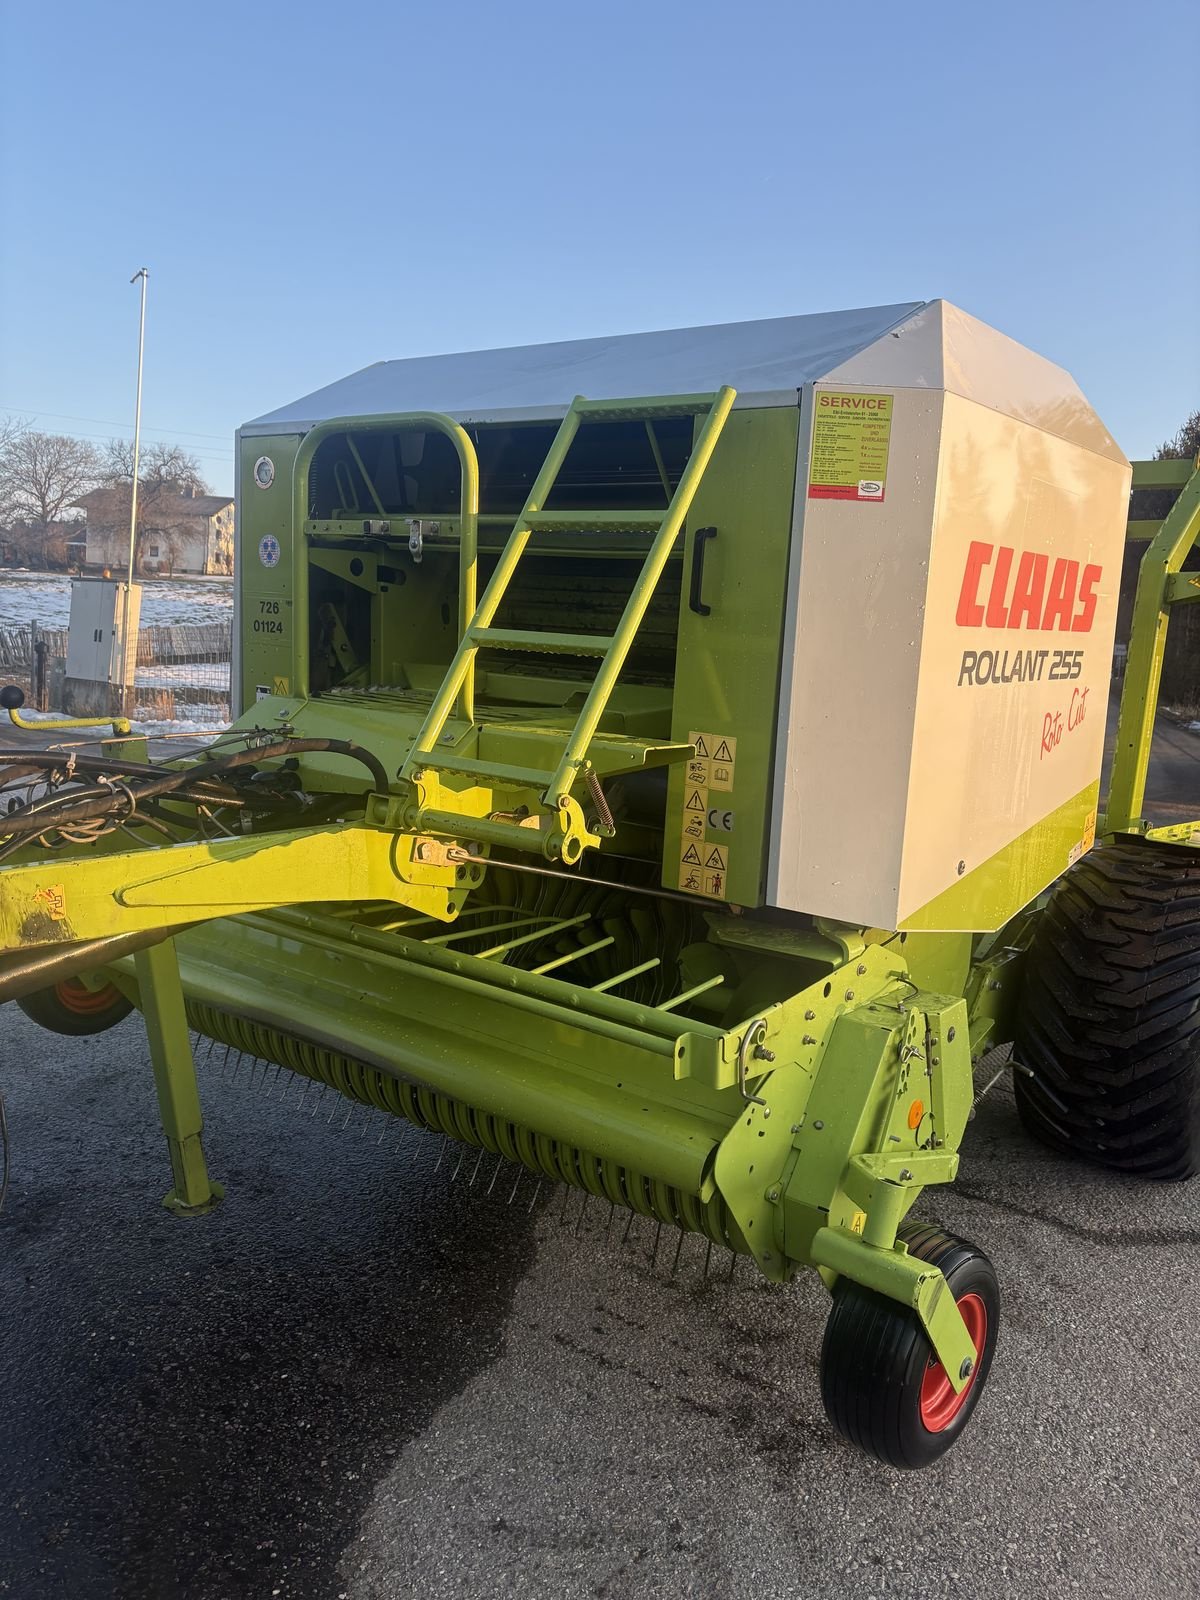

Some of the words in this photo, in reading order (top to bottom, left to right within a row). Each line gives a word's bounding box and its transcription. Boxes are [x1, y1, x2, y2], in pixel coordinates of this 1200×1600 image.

[820, 396, 887, 410] SERVICE
[955, 540, 1103, 632] CLAAS
[260, 601, 280, 615] 726
[253, 620, 284, 634] 01124
[957, 650, 1049, 687] ROLLANT
[1050, 650, 1084, 680] 255
[1040, 711, 1063, 760] Roto
[1068, 686, 1090, 732] Cut
[708, 809, 732, 831] CE
